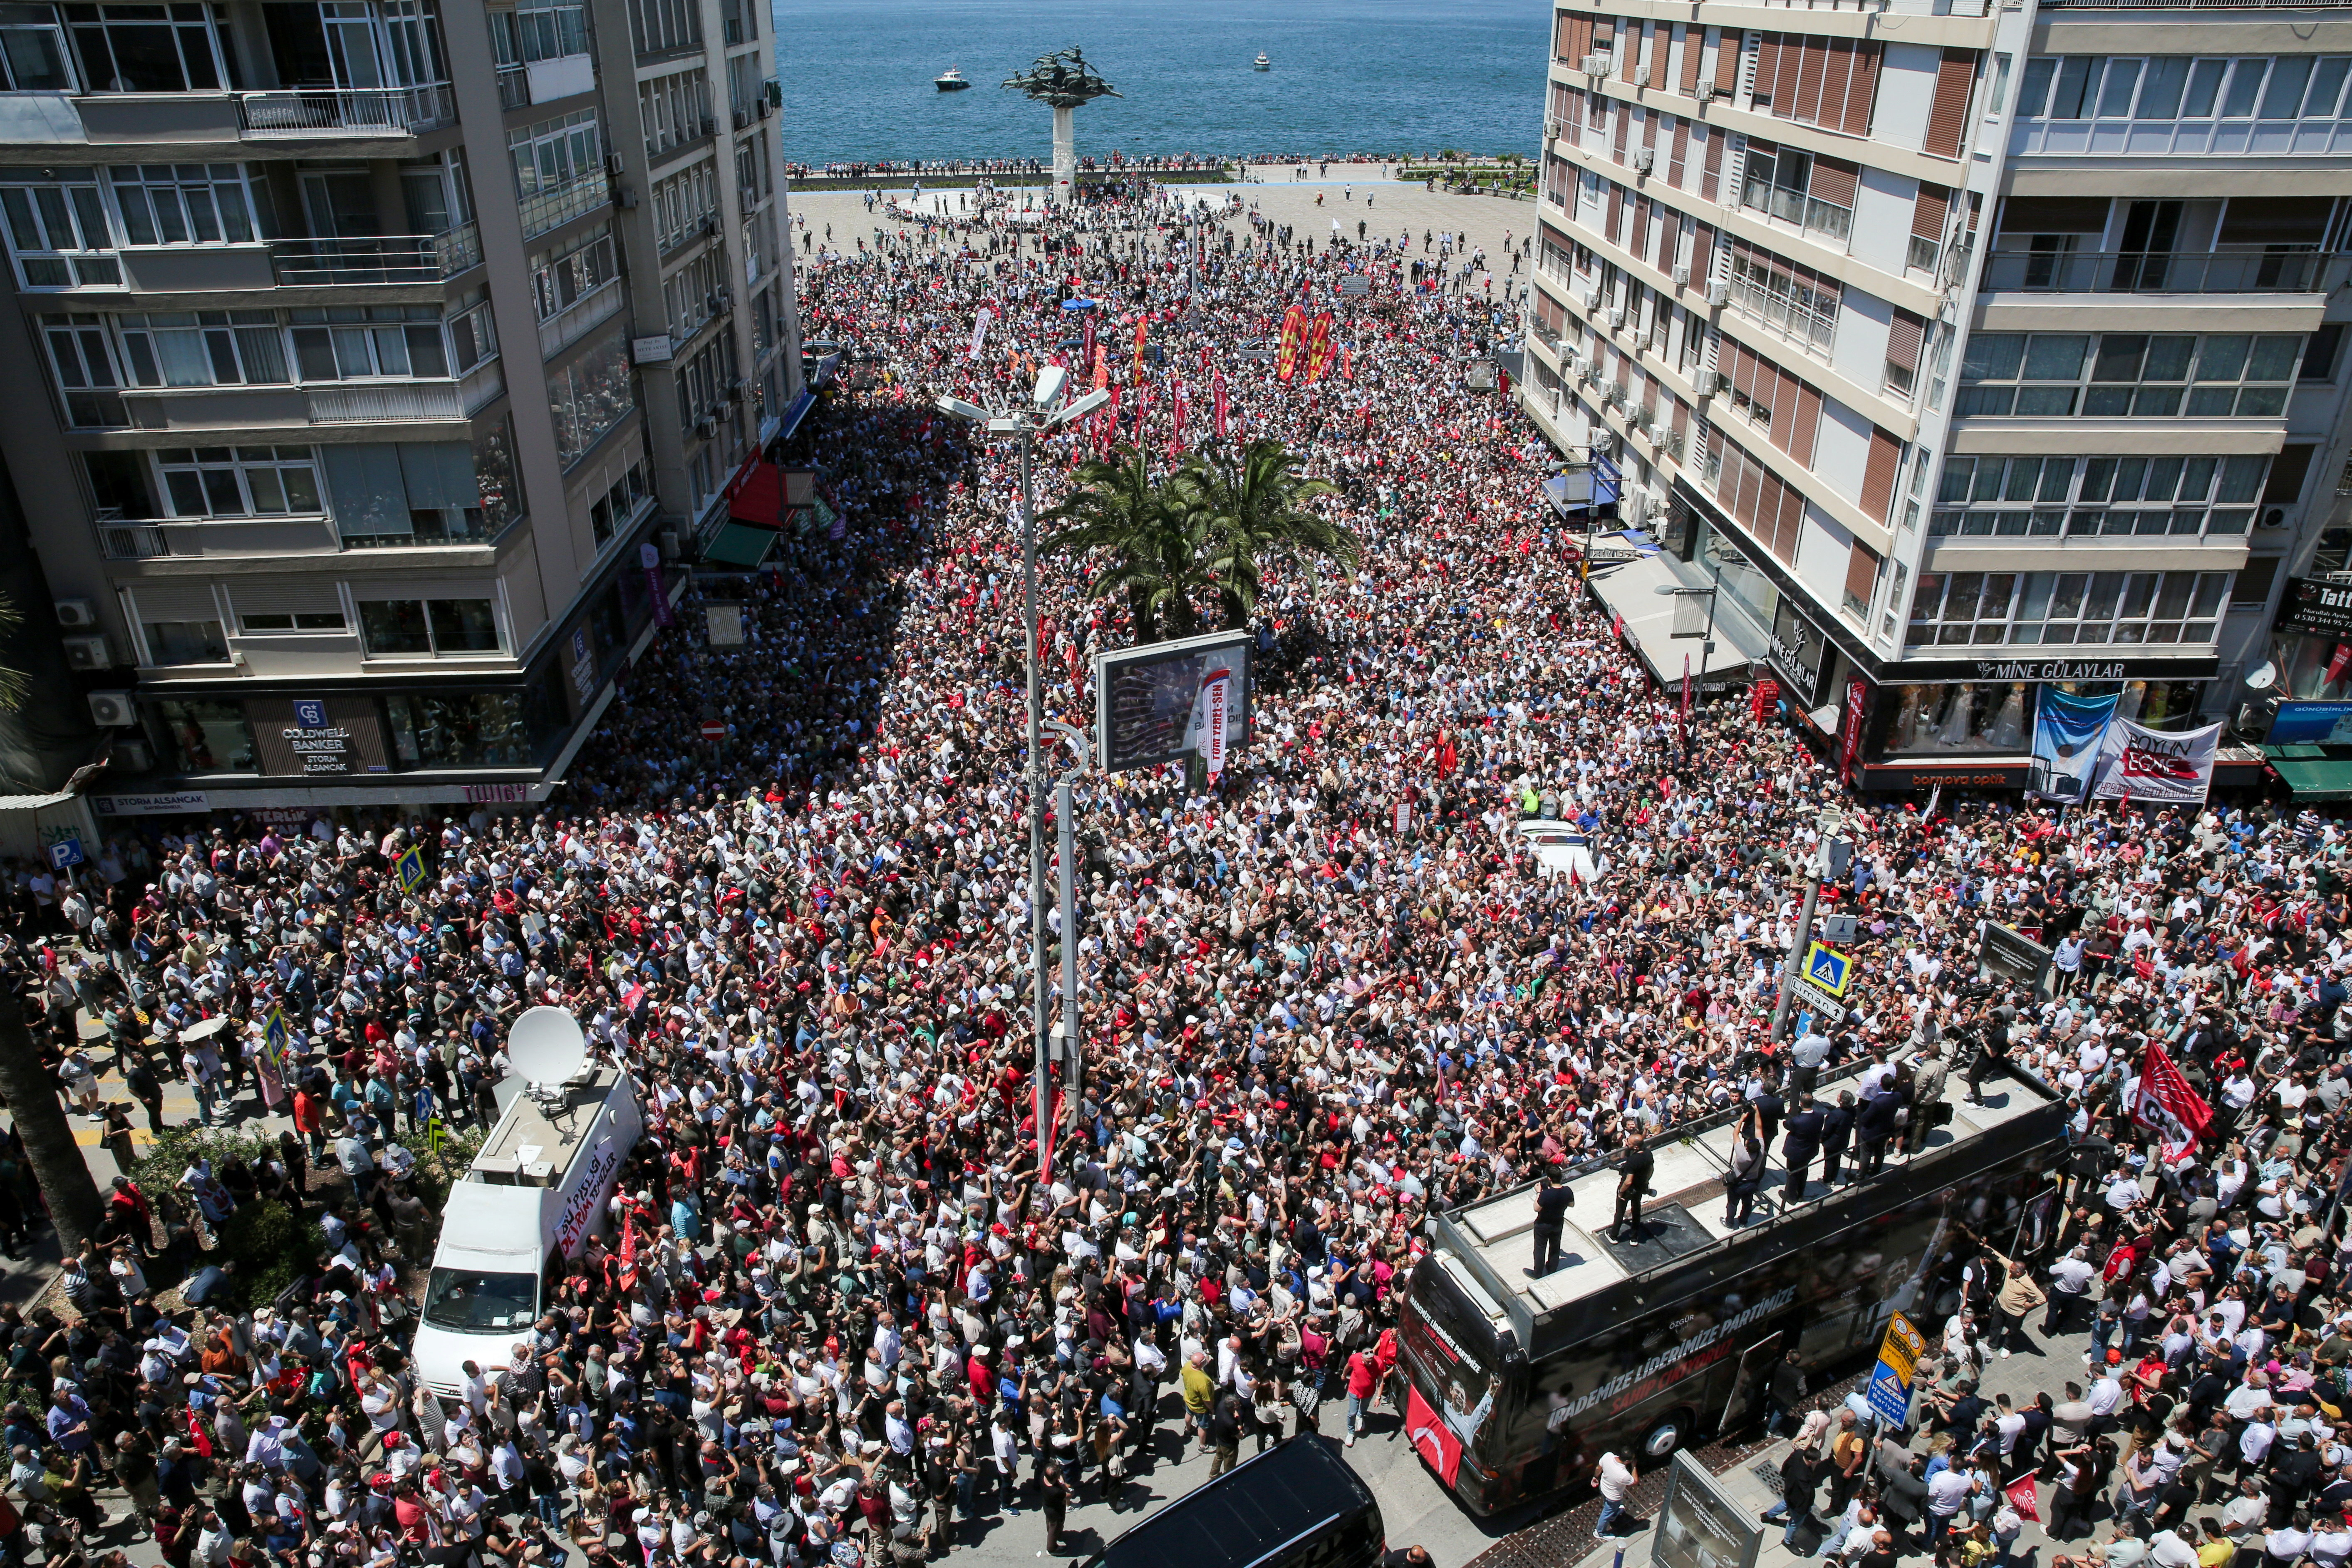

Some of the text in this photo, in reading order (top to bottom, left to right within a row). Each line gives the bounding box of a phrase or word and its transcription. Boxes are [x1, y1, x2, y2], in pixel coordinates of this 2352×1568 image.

[1279, 329, 1298, 378] HKP
[2303, 608, 2330, 617] Nurullah
[1770, 634, 1815, 691] MİNE GÜLAYLAR
[1780, 660, 1801, 686] HAUTE COUTURE
[1995, 660, 2124, 679] MİNE GÜLAYLAR
[282, 728, 350, 739] COLDWELL
[1212, 684, 1223, 760] TÜM YEREL-SEN
[292, 739, 344, 750] BANKER
[2128, 731, 2193, 756] BOYUN
[1912, 774, 2007, 785] bornova optik
[154, 795, 204, 805] ALSANCAK
[252, 809, 308, 823] TERLİK
[52, 844, 69, 868] P
[2000, 949, 2033, 971] DÜŞÜNDÜRMEYEN
[2001, 956, 2021, 969] TEKNOLOJİ
[1792, 980, 1829, 1010] Liman
[1409, 1294, 1482, 1374] İRADEMİZE LİDERİMİZE PARTİMİZE
[1423, 1322, 1436, 1338] SAHİP
[1669, 1314, 1694, 1330] ÖZGÜR
[1547, 1285, 1797, 1429] İRADEMİZE LİDERİMİZE PARTİMİZE
[1884, 1344, 1901, 1363] Hareketli
[1610, 1337, 1735, 1415] SAHİP ÇIKIYORUZ
[1871, 1384, 1905, 1413] Hareketli
[1872, 1393, 1901, 1416] Bariyer
[1678, 1482, 1692, 1496] Arçelik
[1691, 1495, 1700, 1505] Yeni
[1713, 1516, 1731, 1536] Makinesi
[1730, 1533, 1742, 1547] Serisi
[1680, 1491, 1737, 1548] SENİ DÜŞÜNDÜRMEYEN
[1694, 1511, 1720, 1539] TEKNOLOJİ
